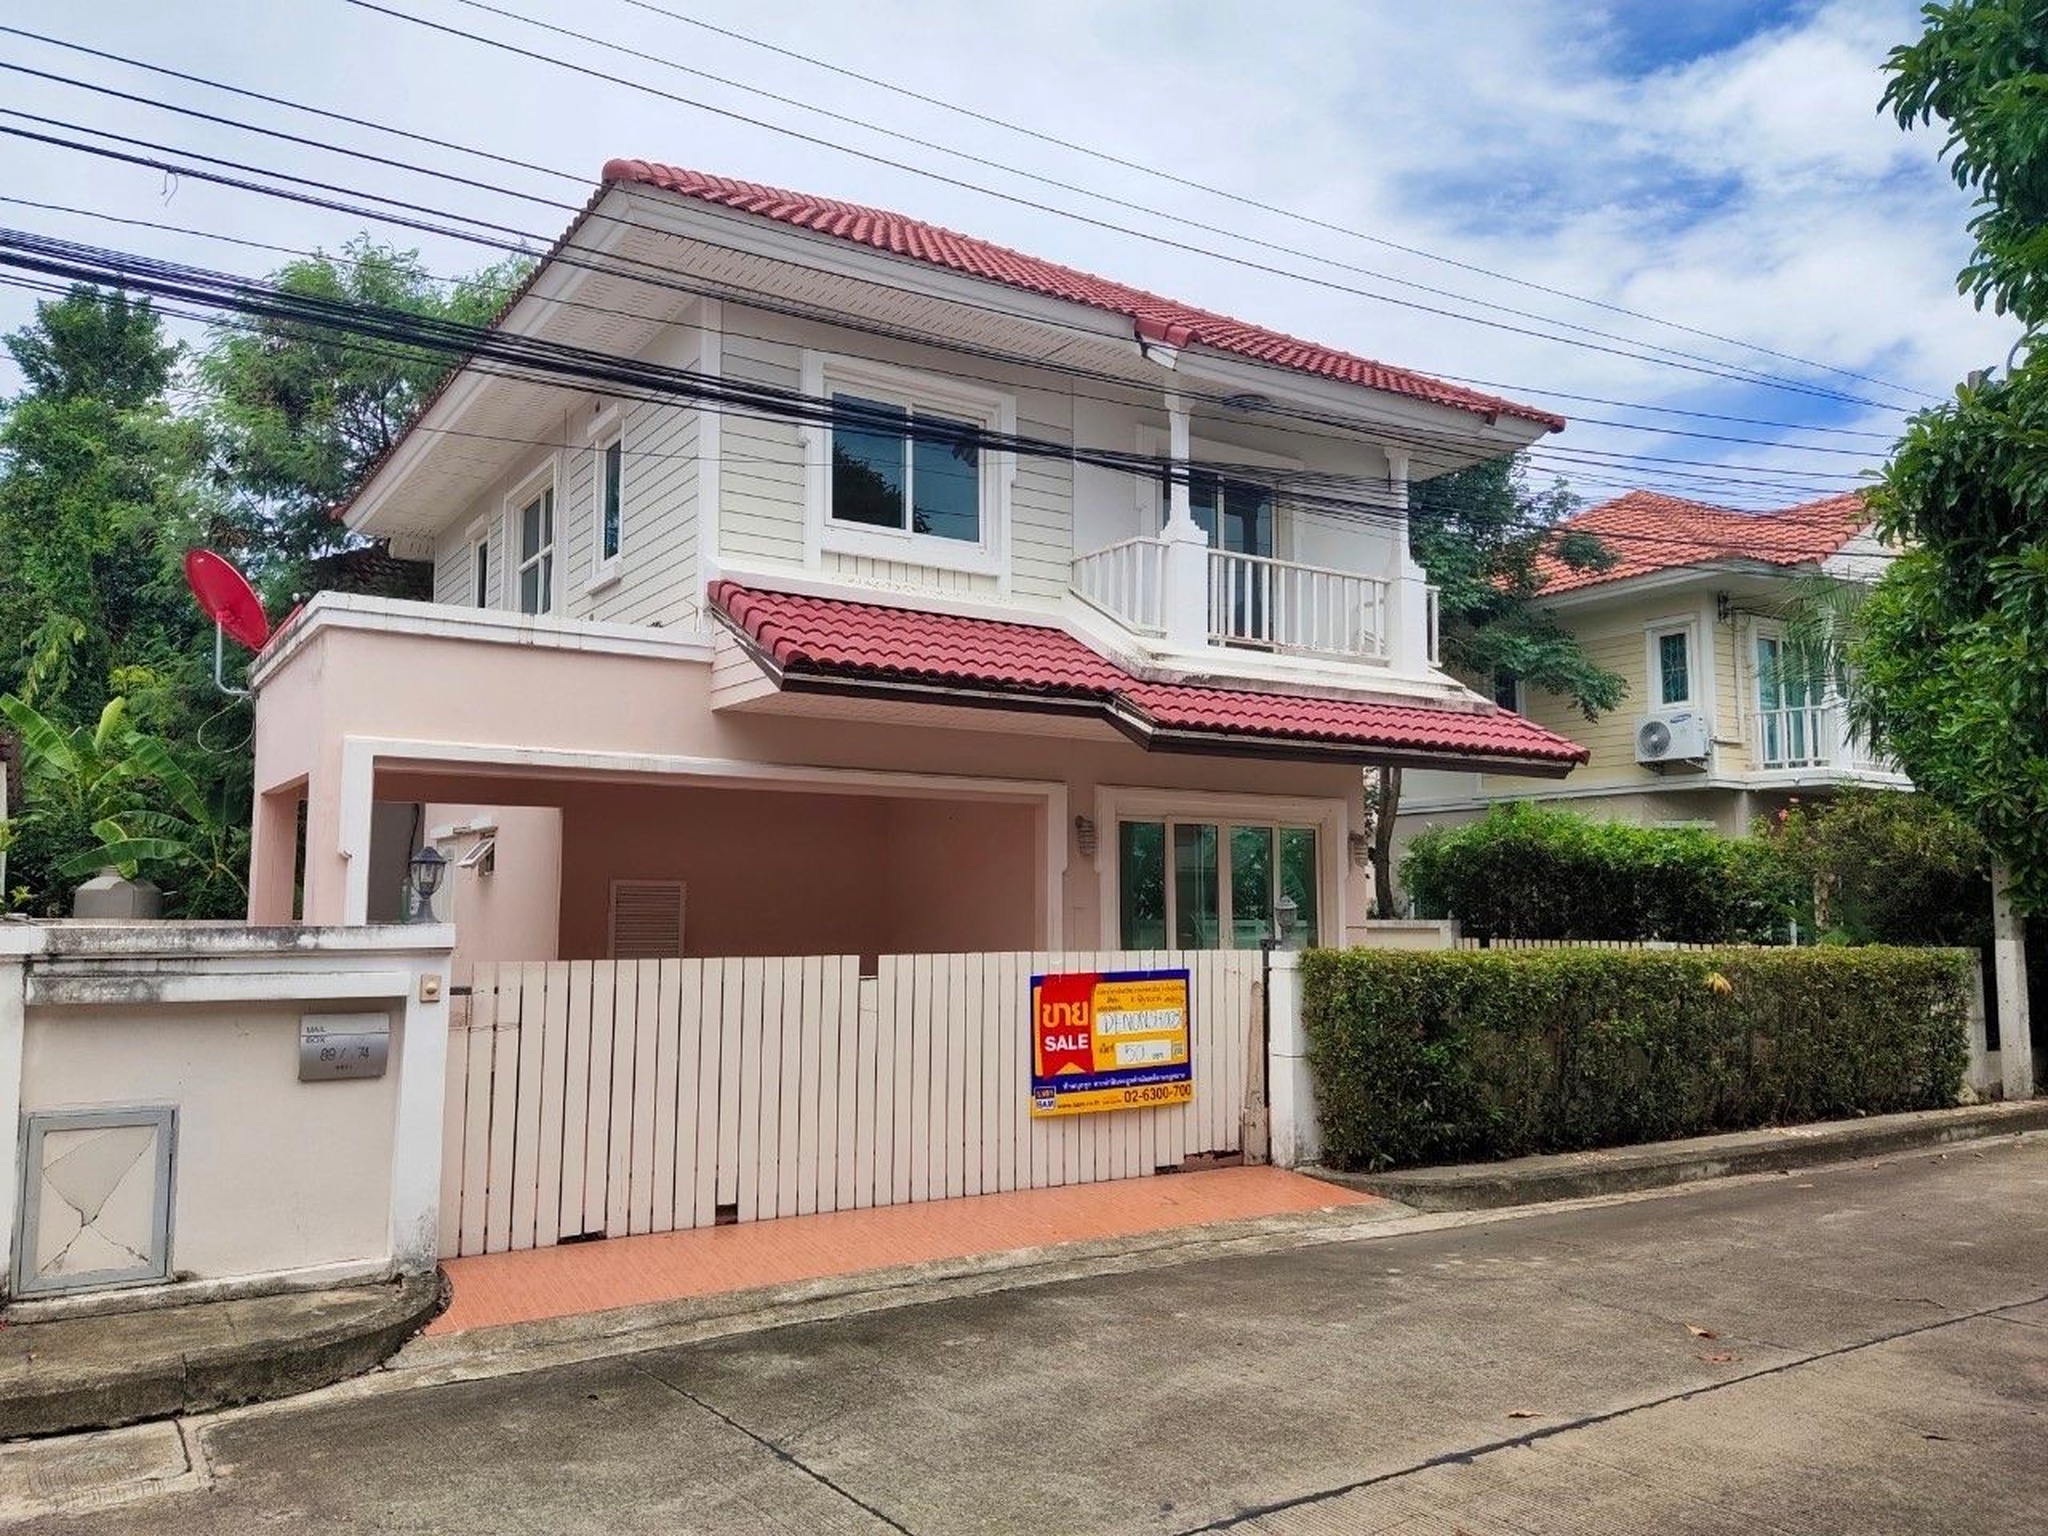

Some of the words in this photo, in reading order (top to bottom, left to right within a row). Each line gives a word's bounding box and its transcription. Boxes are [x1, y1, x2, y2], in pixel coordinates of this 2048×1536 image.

[1042, 1001, 1089, 1028] ขาย
[1044, 1033, 1089, 1052] SALE
[1124, 1083, 1192, 1103] 02-6300-700
